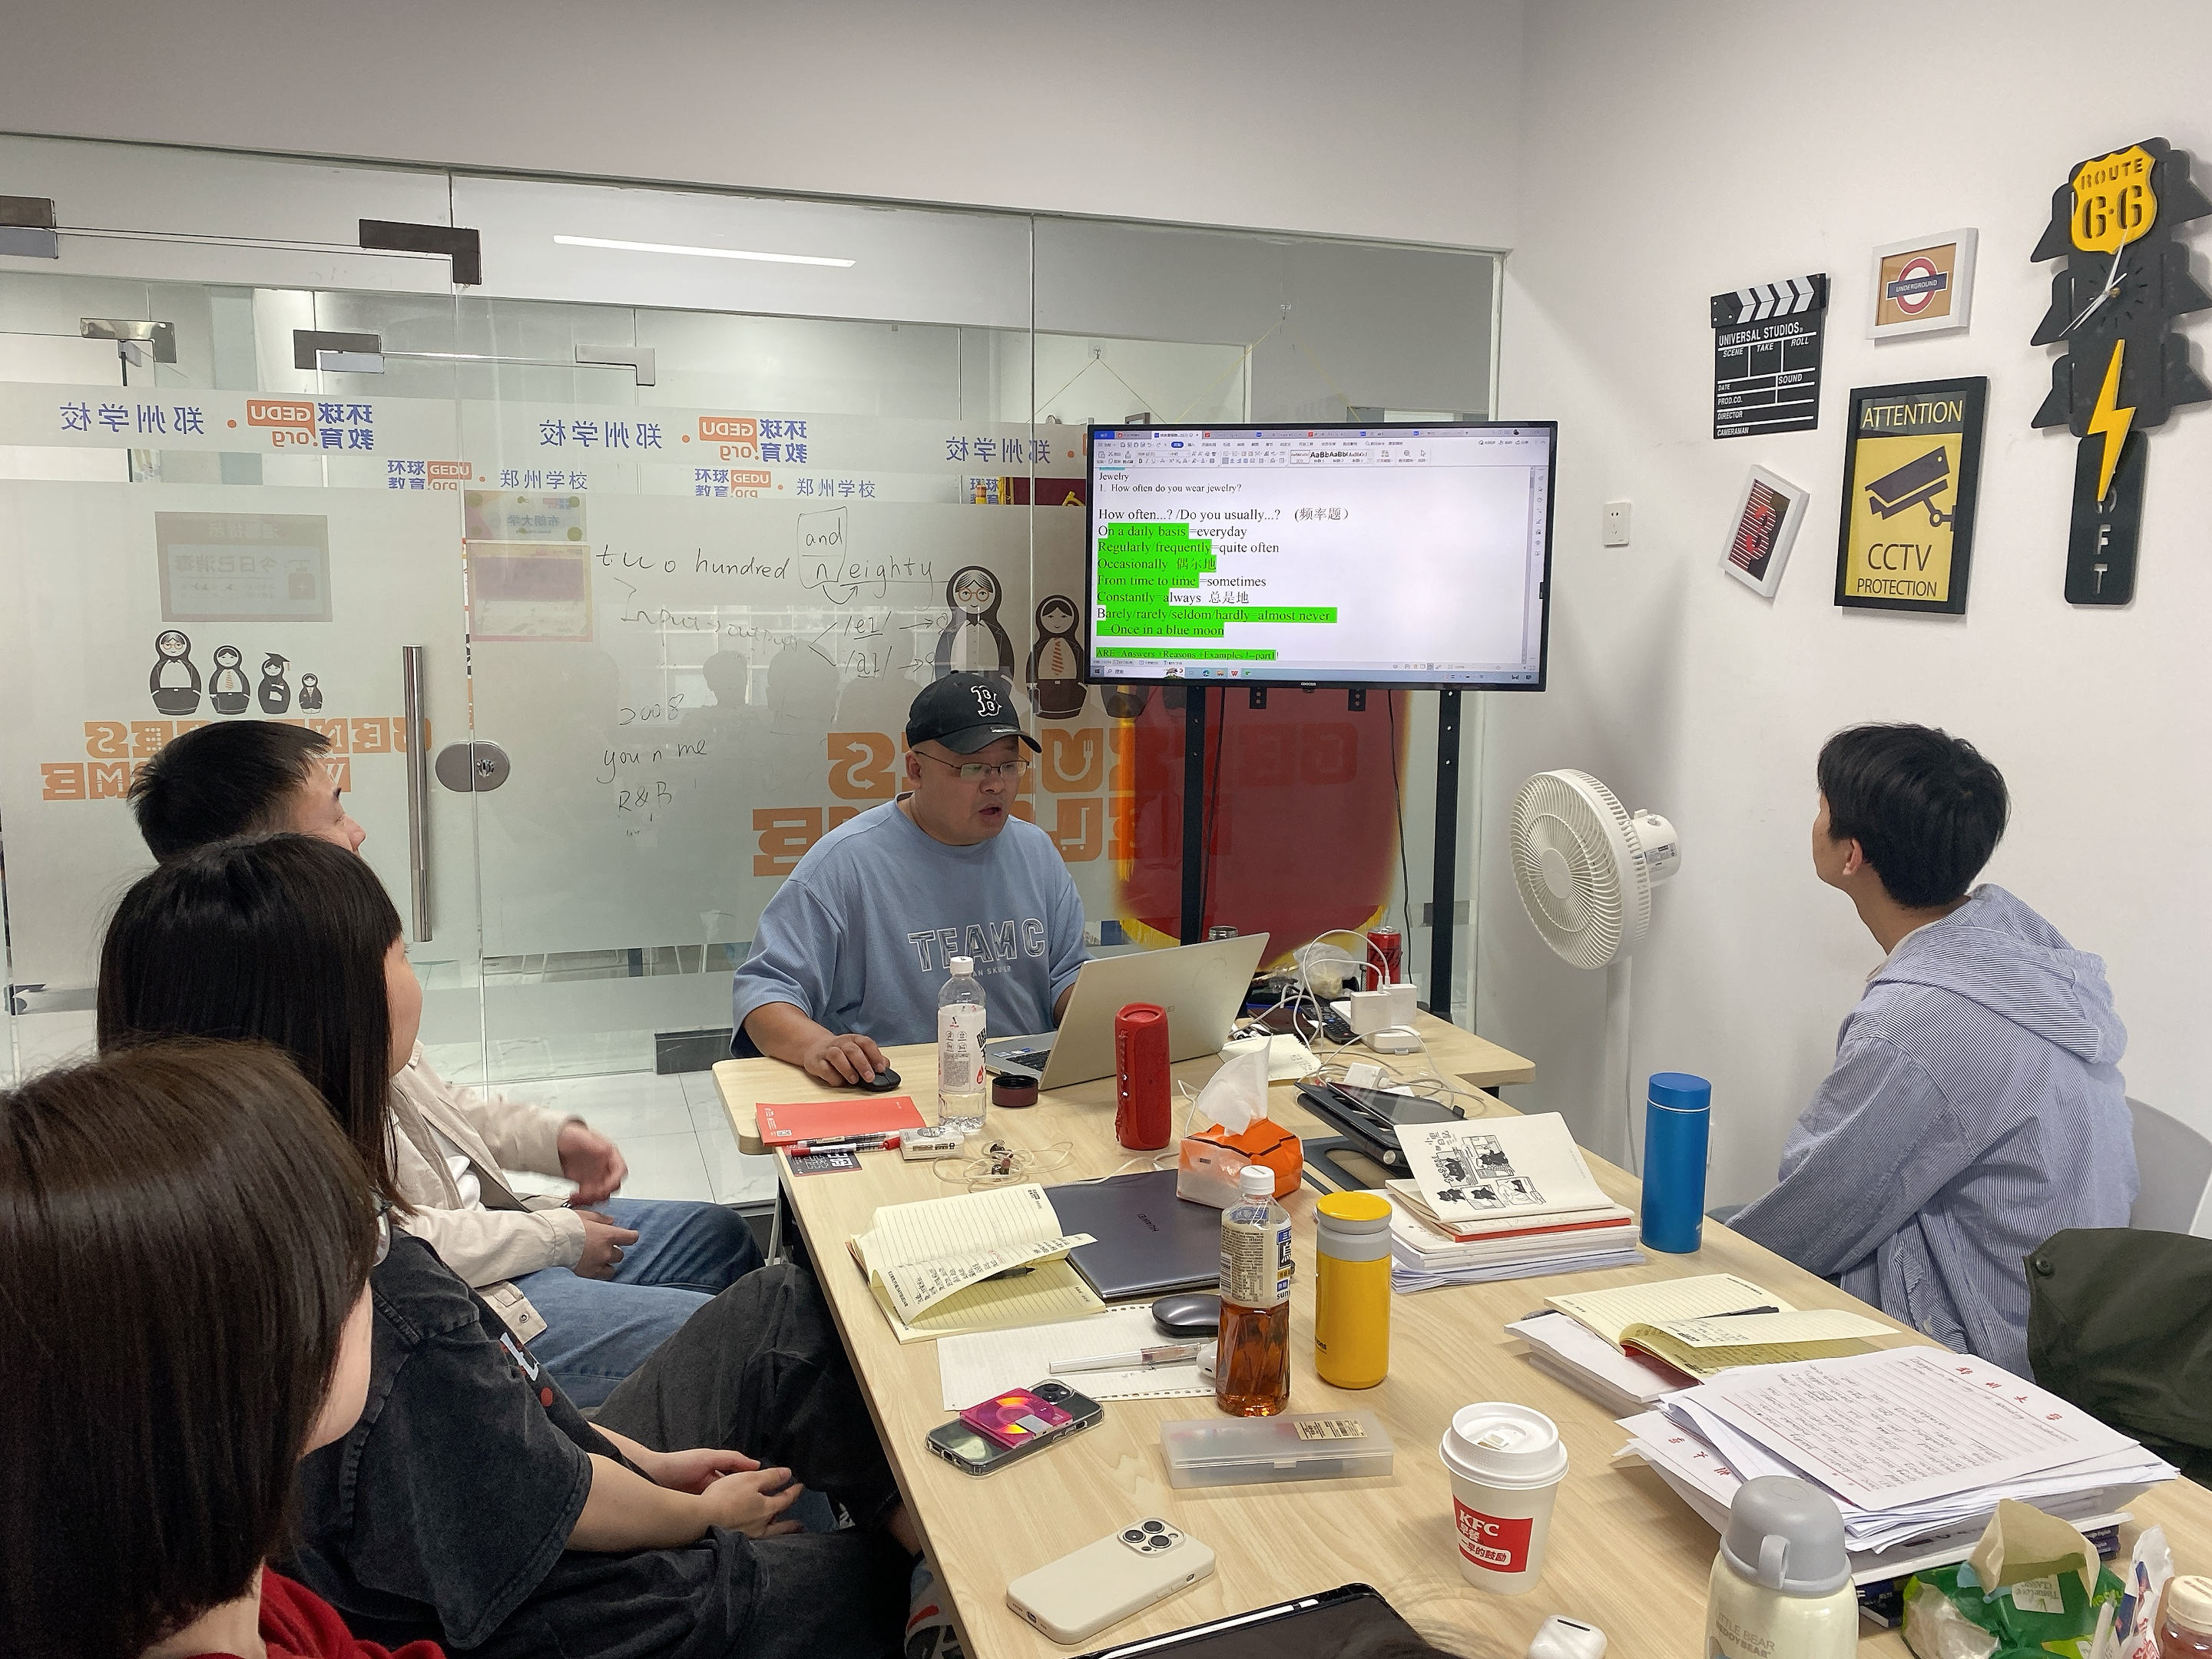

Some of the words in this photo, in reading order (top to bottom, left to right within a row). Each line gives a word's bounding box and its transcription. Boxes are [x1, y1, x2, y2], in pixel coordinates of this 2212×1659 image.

[2081, 158, 2144, 190] ROUTE
[1895, 279, 1938, 293] UNDERGROUND
[1718, 326, 1761, 346] UNIVERSAL
[1763, 321, 1800, 341] STUDIOS
[1756, 342, 1774, 353] TAKE
[1790, 336, 1810, 346] ROLL
[1723, 346, 1743, 357] SCENE
[1778, 373, 1803, 384] SOUND
[1717, 382, 1731, 391] DATE
[1717, 396, 1743, 406] PROD.CO.
[1717, 409, 1743, 420] DIRECTOR
[1862, 399, 1963, 429] ATTENTION
[1717, 426, 1750, 437] CAMERAMAN
[387, 460, 426, 475] 环球
[429, 465, 469, 475] GEDU
[501, 469, 588, 489] 郑州学校
[695, 469, 729, 483] 环球
[733, 473, 769, 483] GEDU
[1099, 472, 1129, 482] Jewelry
[796, 478, 876, 498] 郑州学校
[1132, 484, 1152, 492] often
[1155, 484, 1165, 492] do
[1206, 484, 1241, 494] jewelry?
[1098, 509, 1124, 519] How
[1128, 508, 1172, 520] often...?
[1175, 509, 1197, 520] /Do
[1200, 512, 1220, 522] you
[1224, 509, 1280, 522] usually...?
[805, 517, 844, 547] and
[1098, 525, 1114, 537] On
[1118, 528, 1124, 537] a
[1128, 525, 1154, 539] daily
[1158, 525, 1186, 537] basis
[1250, 541, 1280, 553] often
[1868, 543, 1932, 571] CCTV
[1098, 558, 1167, 571] Occasionally
[695, 547, 790, 580] hundred
[848, 555, 935, 611] eighty
[1098, 575, 1126, 586] From
[1131, 575, 1154, 586] time
[1157, 576, 1168, 586] to
[1171, 576, 1196, 586] time
[1856, 578, 1938, 597] PROTECTION
[1209, 591, 1249, 604] 总是地
[1299, 612, 1330, 621] never
[1143, 624, 1153, 634] in
[1166, 625, 1190, 635] blue
[1193, 628, 1224, 636] moon
[971, 684, 1002, 717] B
[596, 749, 641, 783] you
[677, 739, 708, 756] me
[1460, 1509, 1499, 1537] KFC
[1460, 1522, 1480, 1542] 早餐
[1461, 1538, 1506, 1562] 一早的鼓励
[1743, 1630, 1775, 1651] BEAR
